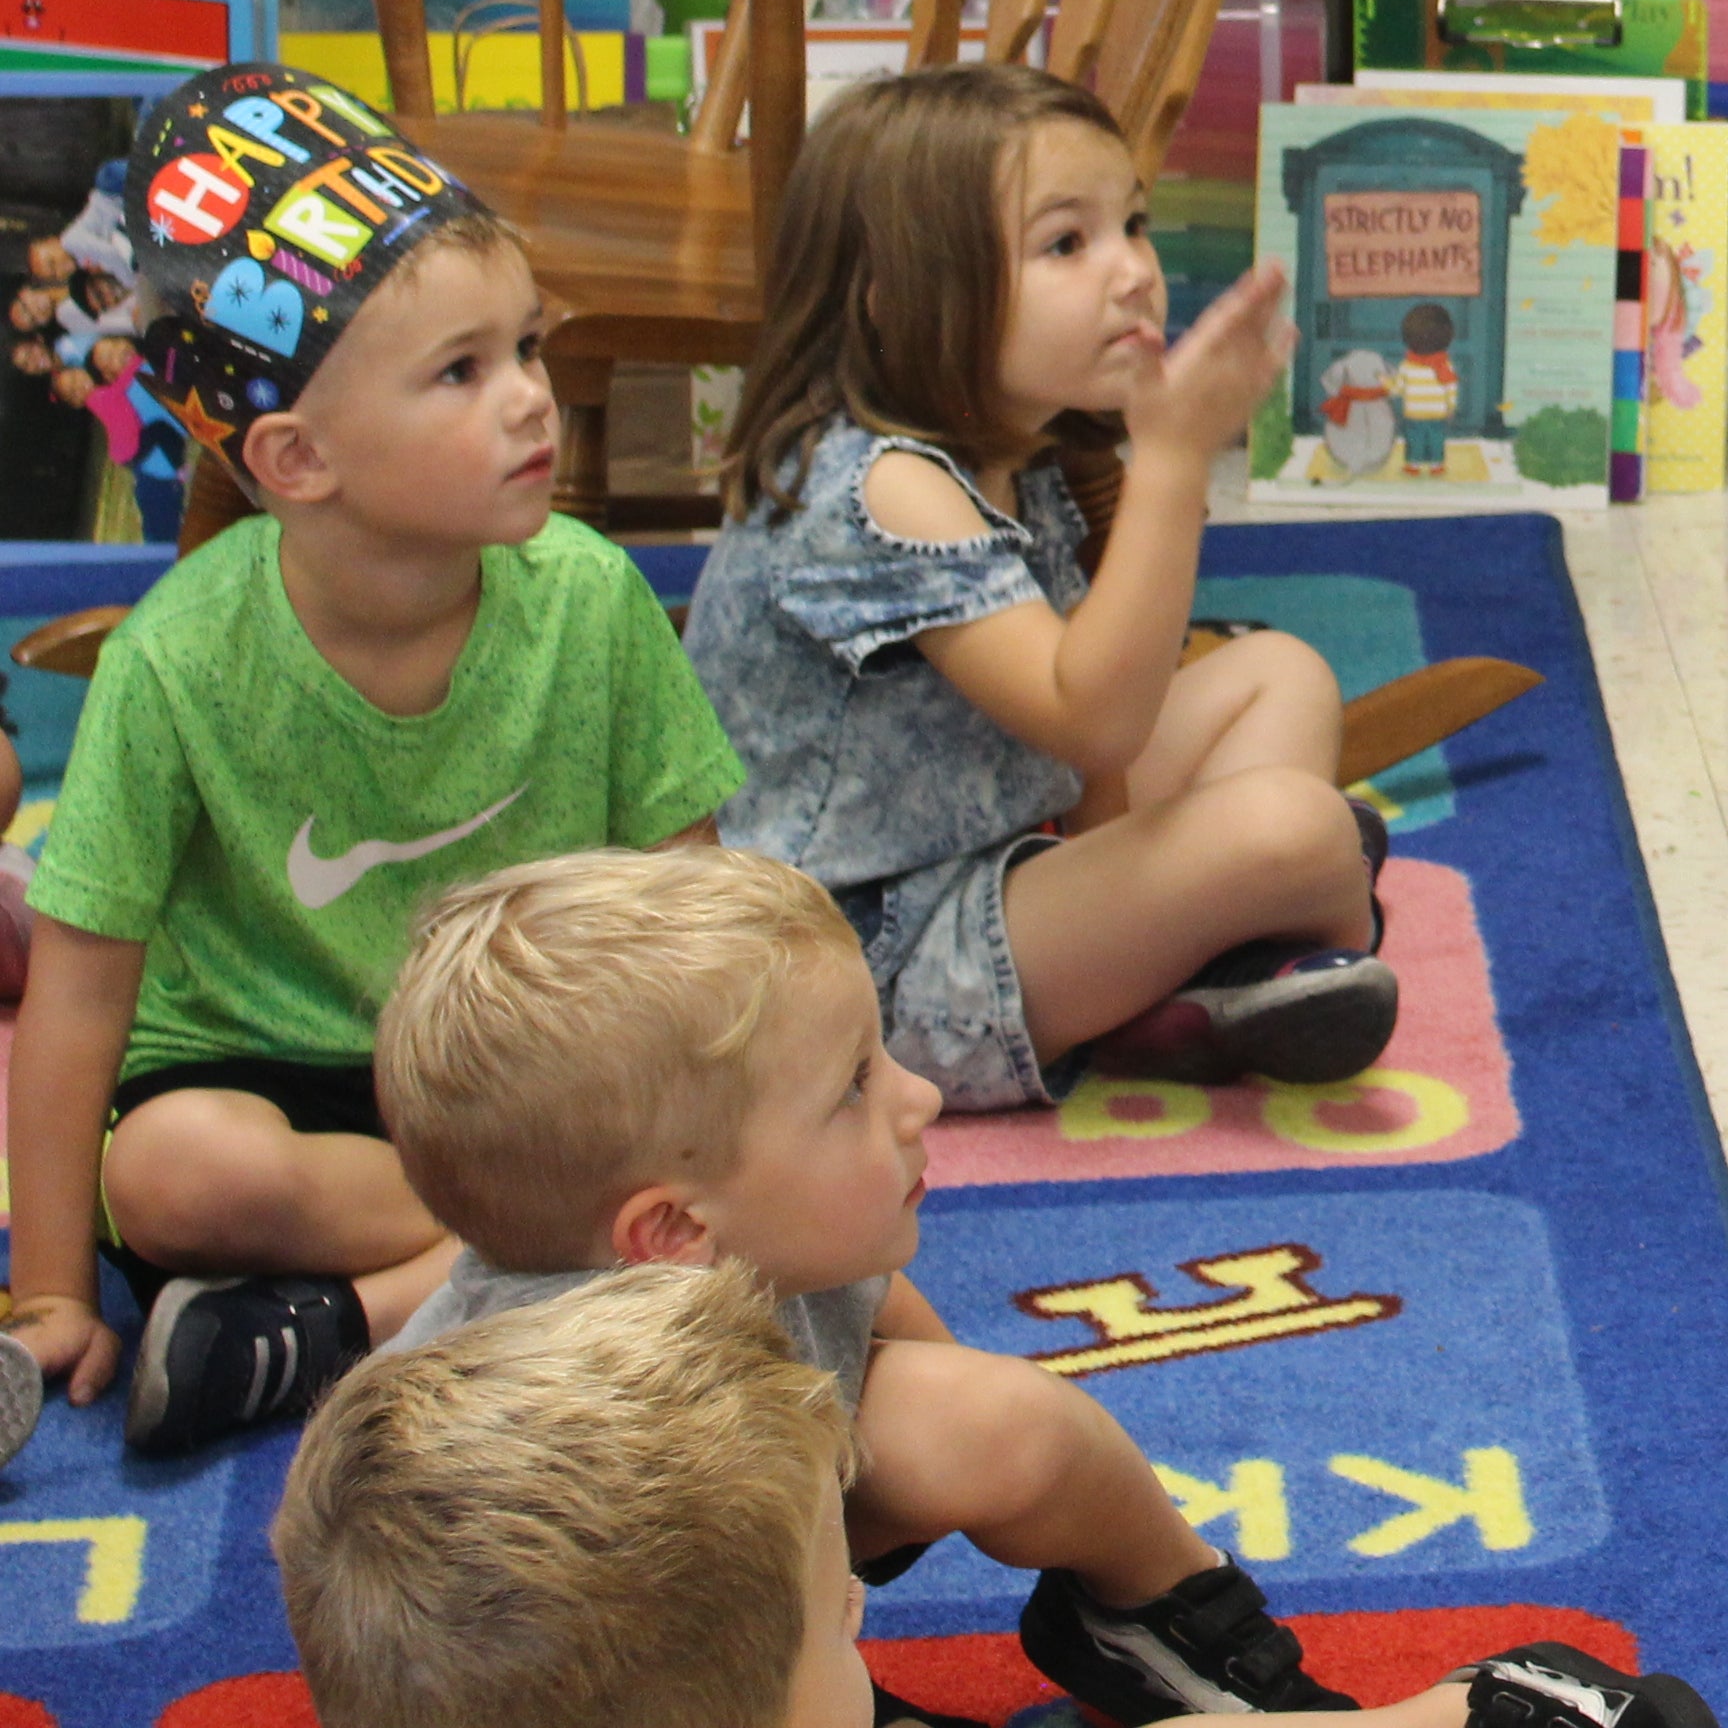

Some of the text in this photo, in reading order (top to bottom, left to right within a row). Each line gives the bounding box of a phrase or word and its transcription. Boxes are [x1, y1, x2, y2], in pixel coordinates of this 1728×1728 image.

[153, 84, 394, 239] HAPPY
[1329, 204, 1474, 235] STRICTLY NO
[1333, 242, 1475, 278] ELEPHANTS
